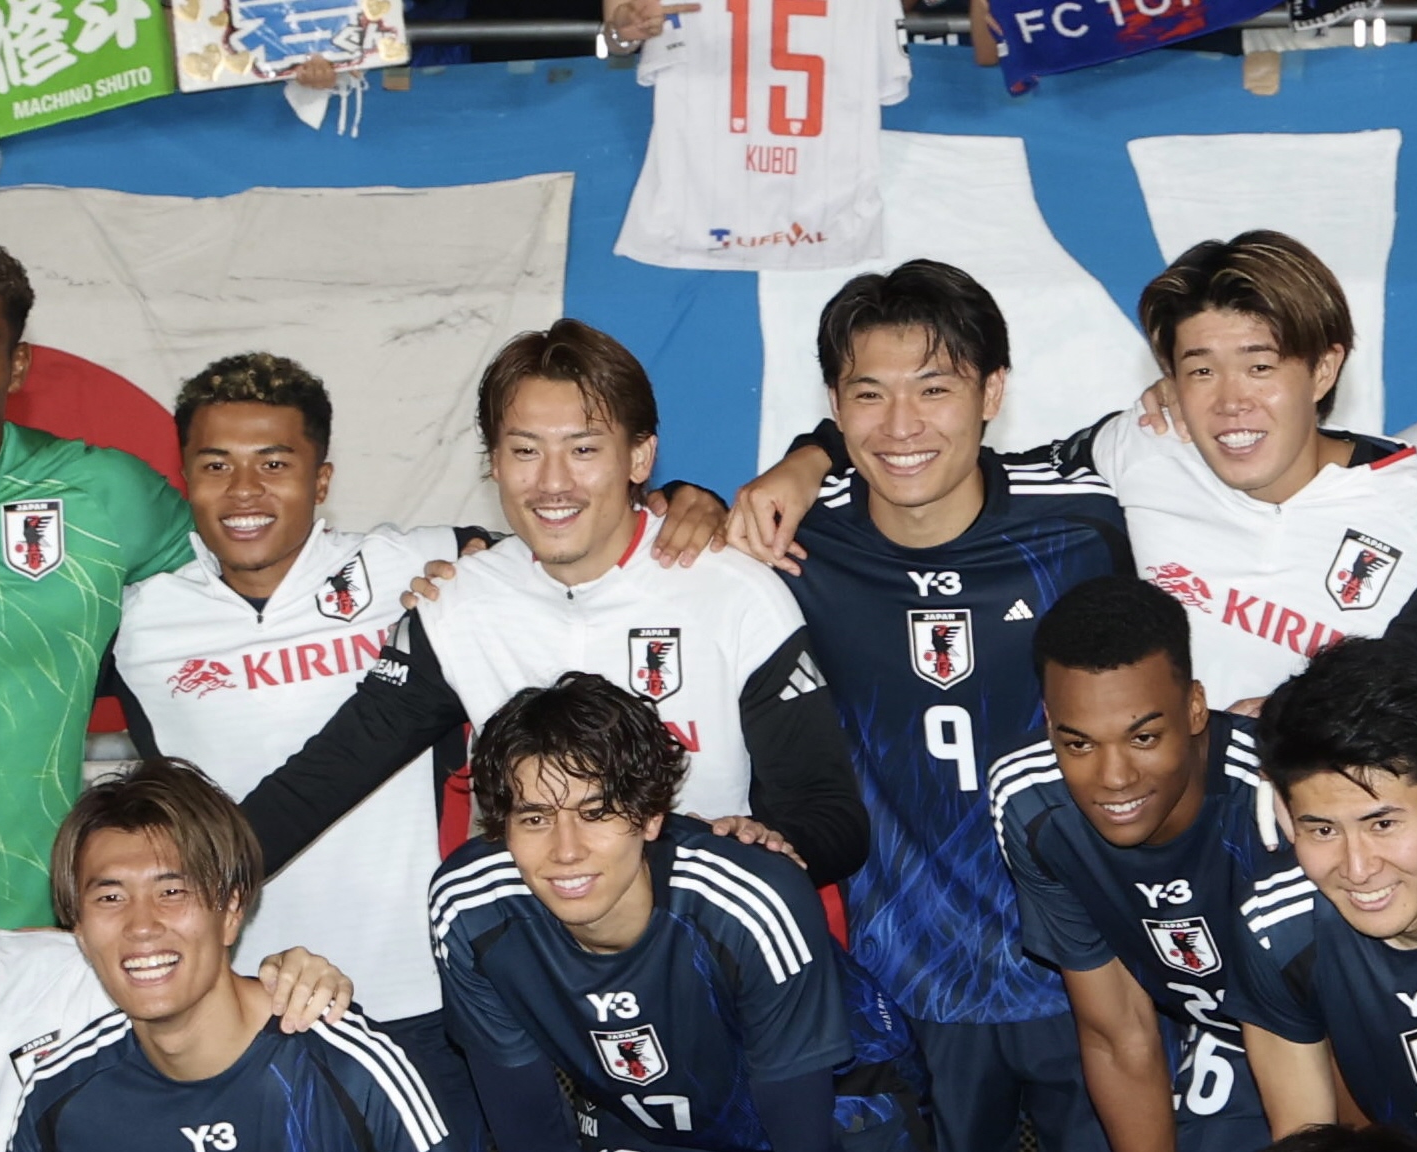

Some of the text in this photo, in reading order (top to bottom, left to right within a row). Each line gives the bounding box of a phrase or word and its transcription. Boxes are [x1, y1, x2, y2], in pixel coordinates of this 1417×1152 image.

[1016, 2, 1090, 43] FC
[726, 0, 828, 137] 15
[13, 66, 152, 120] MACHINO SHUTO
[745, 145, 798, 175] KUBO
[15, 503, 49, 512] JAPAN
[907, 570, 963, 597] Y-3
[638, 629, 671, 637] JAPAN
[924, 704, 979, 792] 9
[1135, 878, 1193, 909] Y-3
[585, 990, 641, 1023] Y-3
